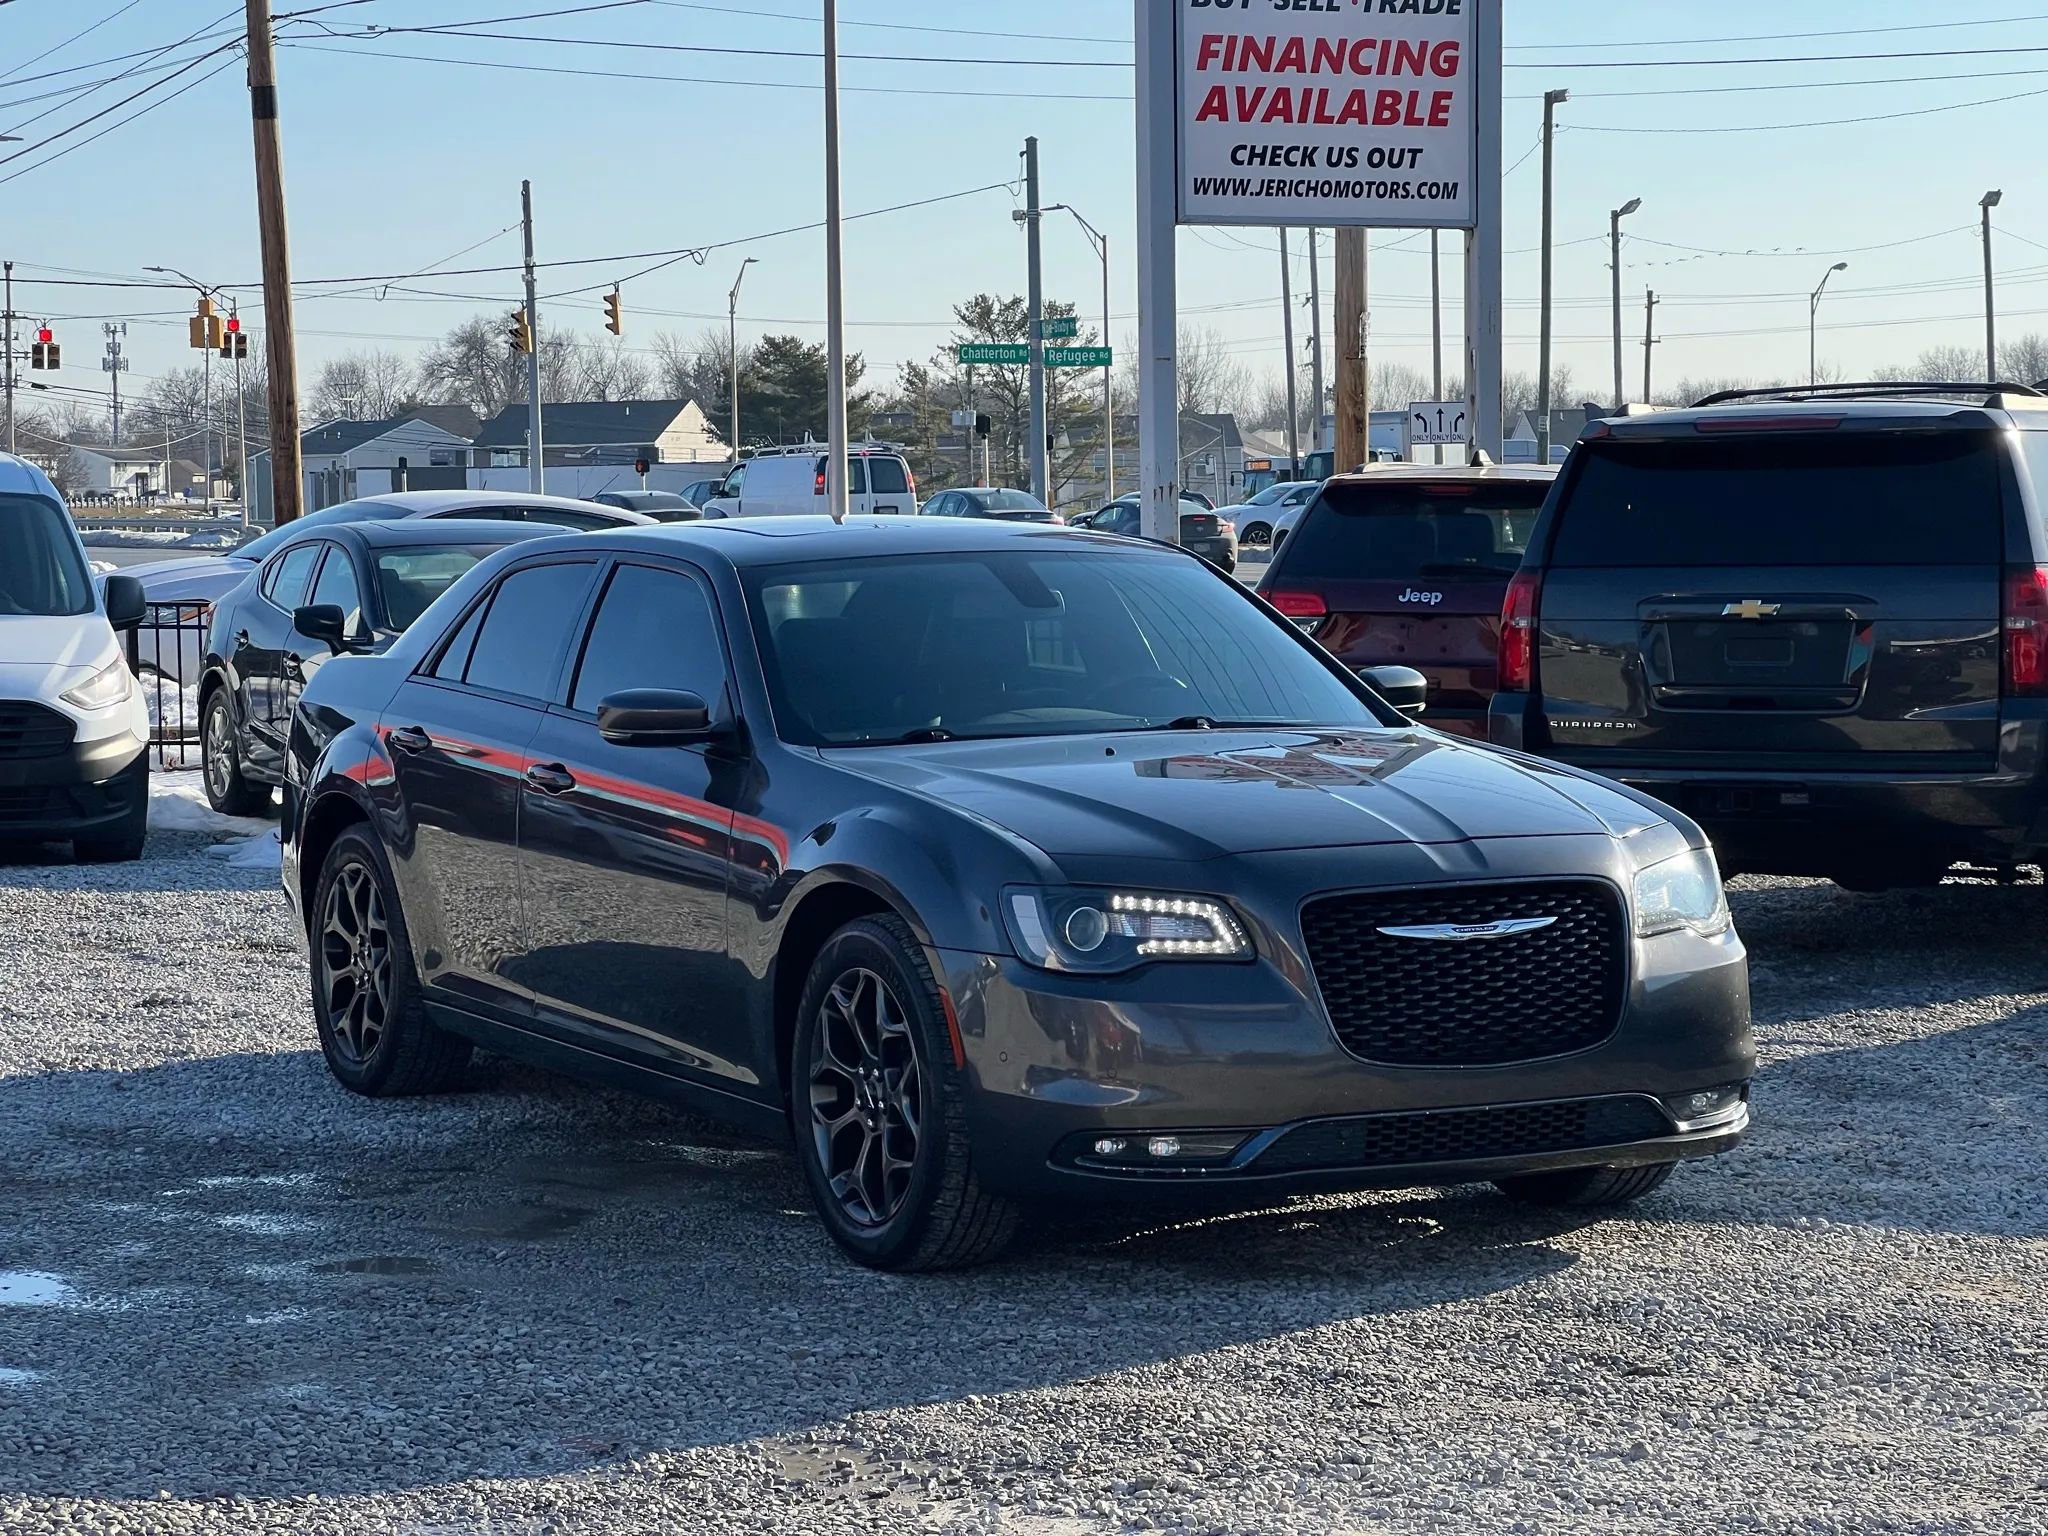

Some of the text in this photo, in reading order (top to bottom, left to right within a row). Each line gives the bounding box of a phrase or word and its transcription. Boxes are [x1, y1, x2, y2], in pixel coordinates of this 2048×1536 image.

[1363, 0, 1461, 15] TRADE
[1196, 34, 1460, 77] FINANCING
[1195, 85, 1453, 127] AVAILABLE
[1230, 144, 1423, 169] CHECK US OUT
[1193, 177, 1458, 200] WWW.JERICHOMOTORS.COM
[961, 347, 1016, 359] Chatterton
[1048, 349, 1109, 365] Refugee Rd
[1411, 434, 1430, 442] ONLY
[1431, 433, 1450, 441] ONLY
[1398, 587, 1443, 606] Jeep
[1550, 720, 1636, 729] SUBURBAN
